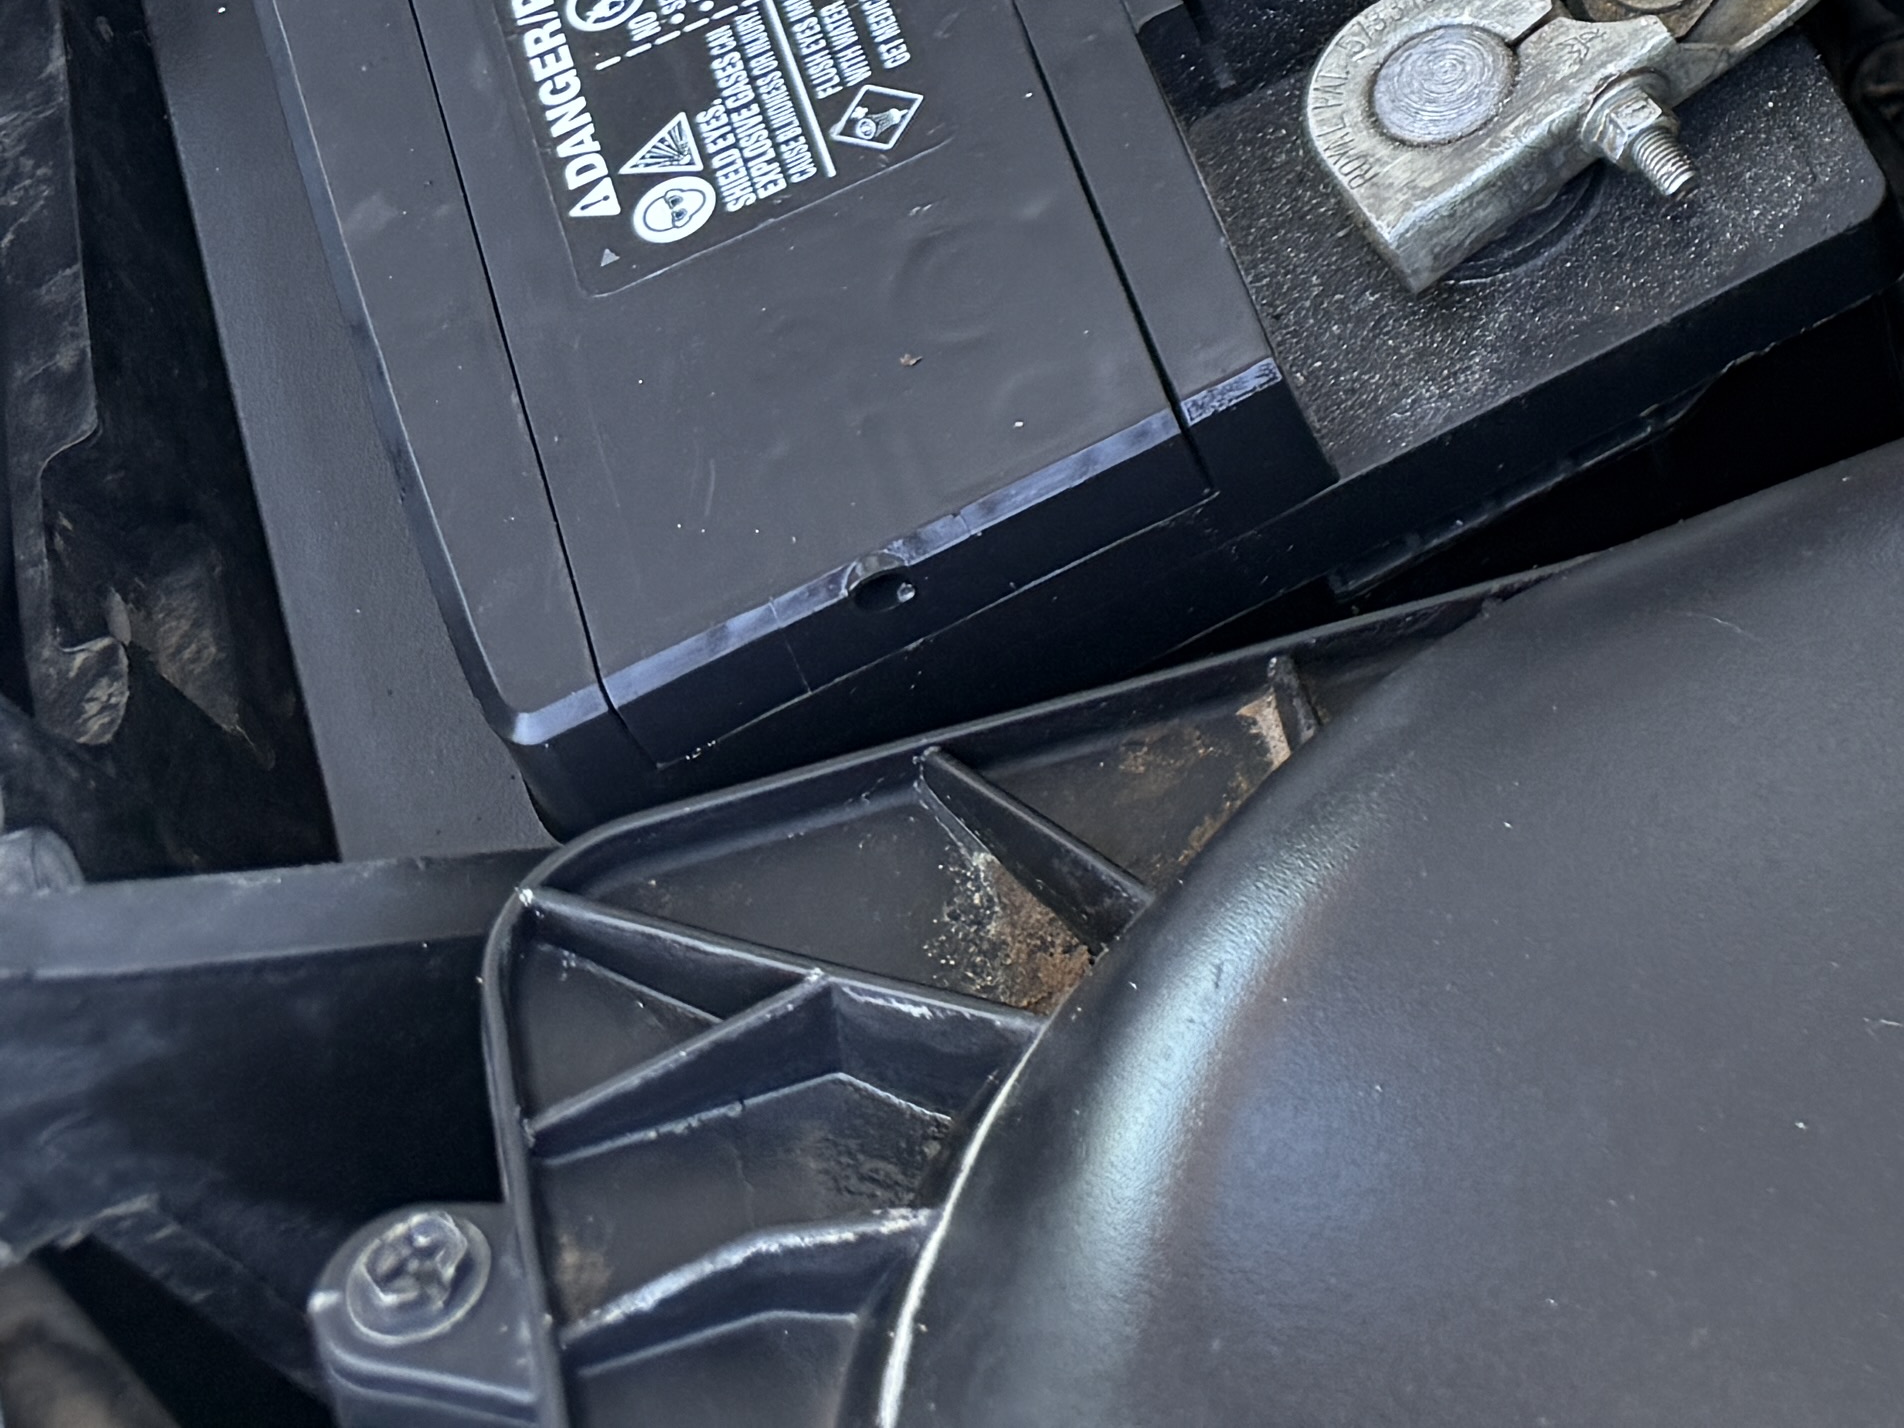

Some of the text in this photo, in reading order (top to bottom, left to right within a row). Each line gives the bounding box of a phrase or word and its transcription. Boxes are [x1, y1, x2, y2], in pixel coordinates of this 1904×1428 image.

[625, 7, 662, 43] NO
[789, 13, 827, 57] EYES
[802, 47, 844, 101] FLUSH
[834, 43, 873, 88] WITH
[874, 34, 912, 72] GET
[703, 22, 788, 201] EXPLOSIVE GASES CAN
[731, 4, 818, 186] CAUSE BLINDNESS OR INJURY.
[691, 96, 757, 215] SHIELD EYES.
[1316, 113, 1381, 191] ROYAL
